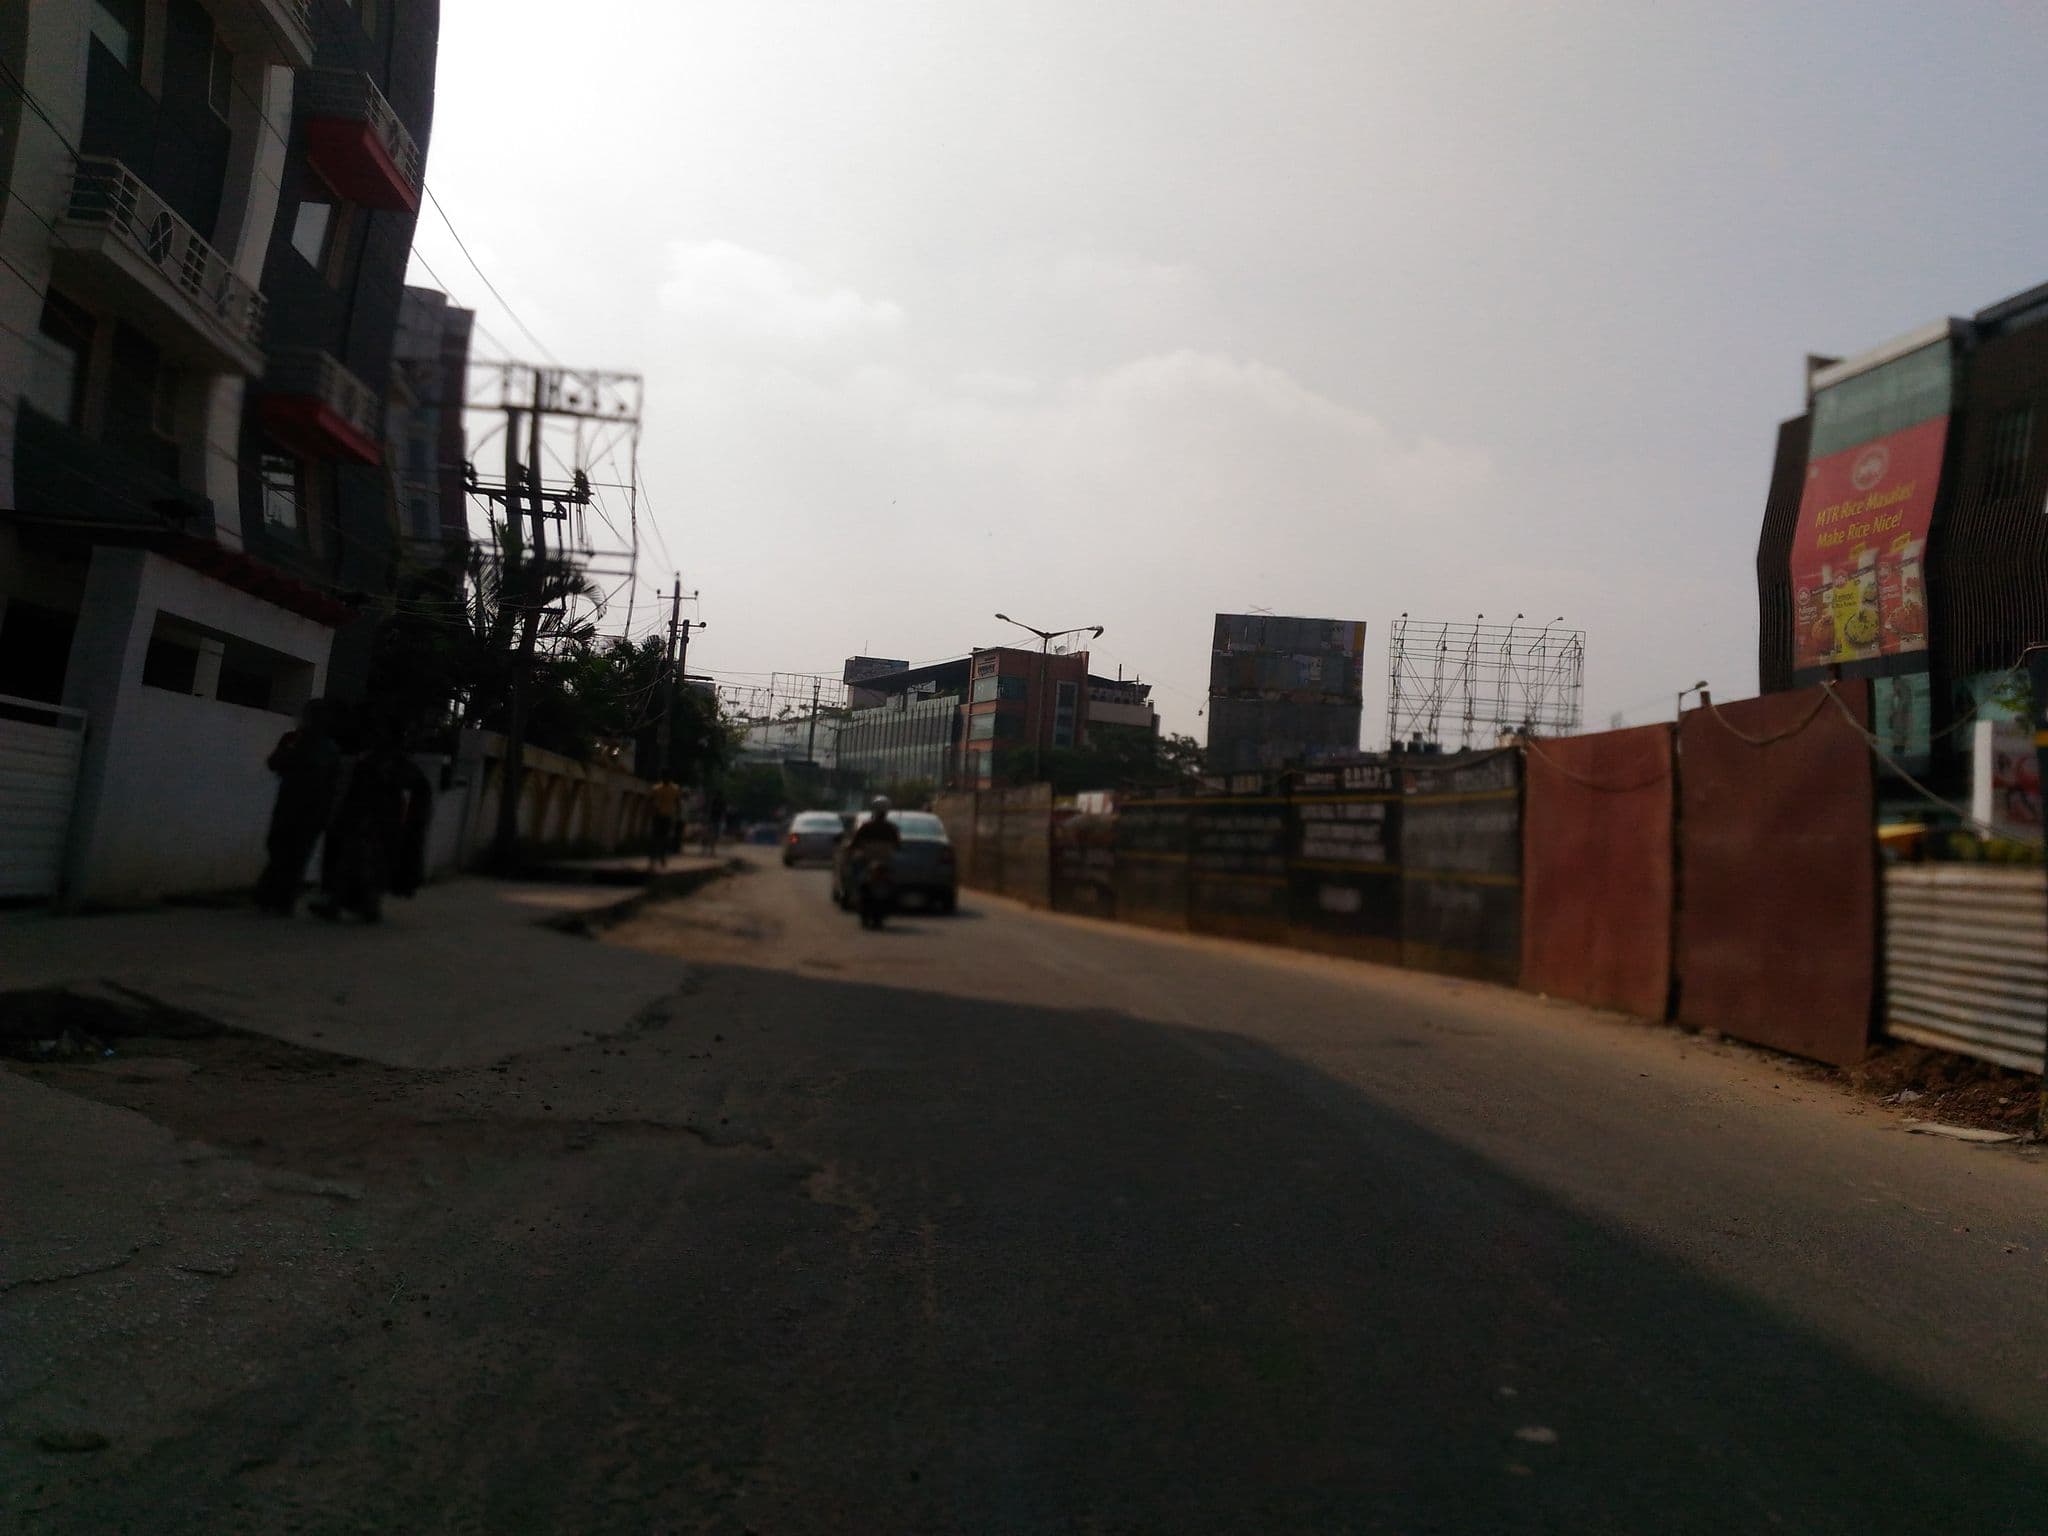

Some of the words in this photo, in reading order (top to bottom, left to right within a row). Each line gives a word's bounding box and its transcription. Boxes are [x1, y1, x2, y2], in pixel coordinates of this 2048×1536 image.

[1816, 504, 1840, 527] MTR
[1817, 530, 1845, 549] Make
[1847, 523, 1870, 540] Rice
[1872, 509, 1903, 533] Nice!
